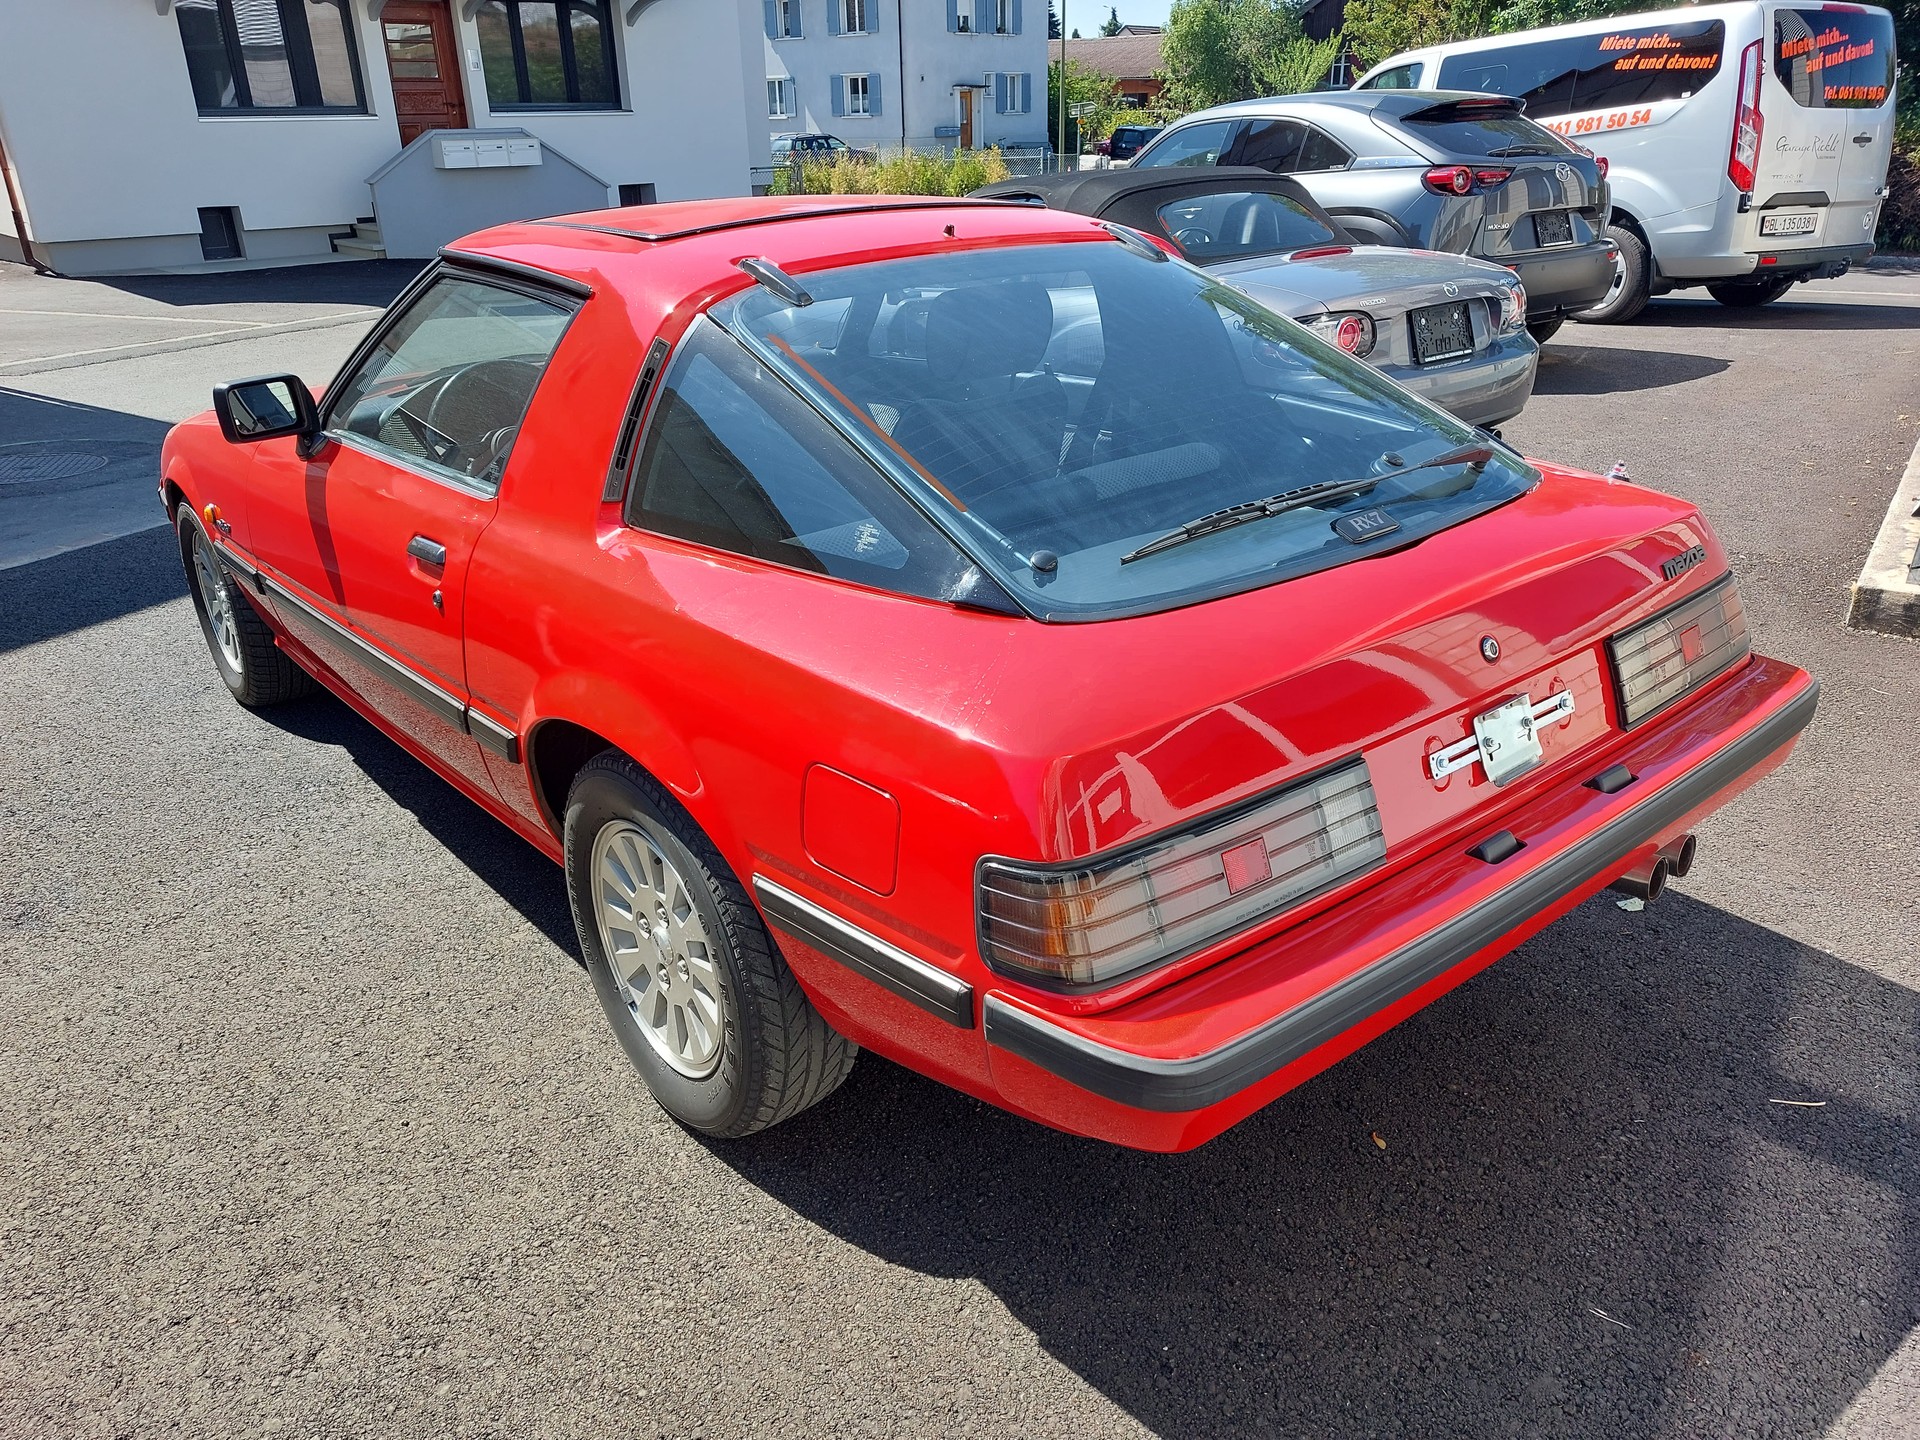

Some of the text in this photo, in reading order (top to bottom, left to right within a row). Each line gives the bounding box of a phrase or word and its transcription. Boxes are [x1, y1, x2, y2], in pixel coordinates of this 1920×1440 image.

[1599, 33, 1681, 51] Miete mich...
[1781, 27, 1849, 59] Miete mich...
[1614, 54, 1718, 71] auf und davon!
[1806, 38, 1874, 74] auf und davon!
[1823, 85, 1838, 99] Tel.
[1838, 86, 1854, 100] 061
[1854, 86, 1868, 99] 981
[1575, 115, 1603, 134] 981
[1606, 112, 1628, 129] 50
[1630, 108, 1652, 126] 54
[1775, 135, 1811, 160] Garage
[1348, 511, 1385, 531] RX-7
[1661, 544, 1707, 581] mazda
